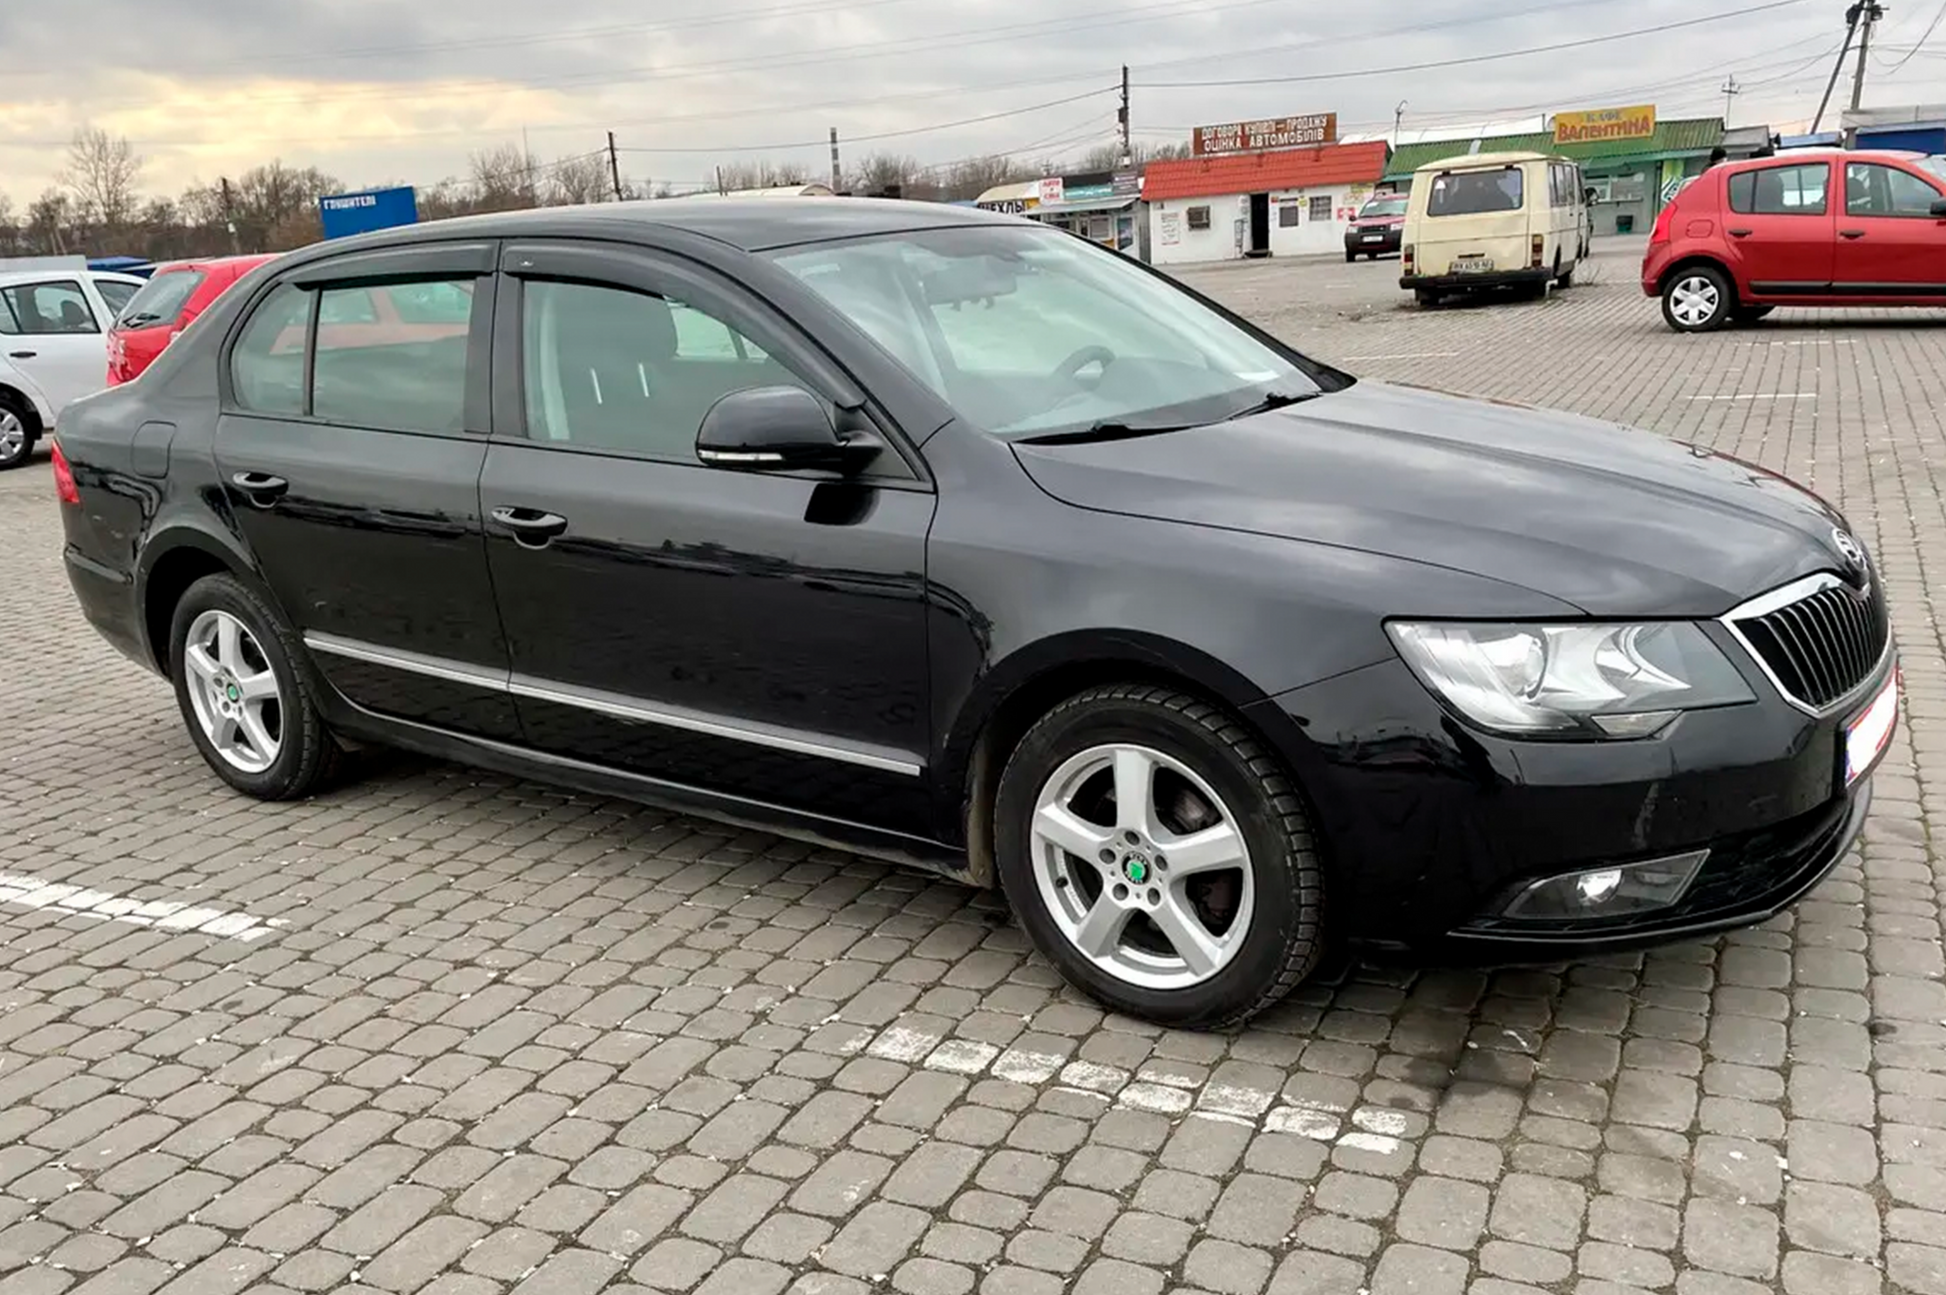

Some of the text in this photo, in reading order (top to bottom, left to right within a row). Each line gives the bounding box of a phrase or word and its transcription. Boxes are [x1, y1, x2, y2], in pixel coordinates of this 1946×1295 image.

[1204, 128, 1324, 152] ОЦІНКА АВТОМОБІЛІВ
[1557, 115, 1651, 142] ВАЛЕНТИНА
